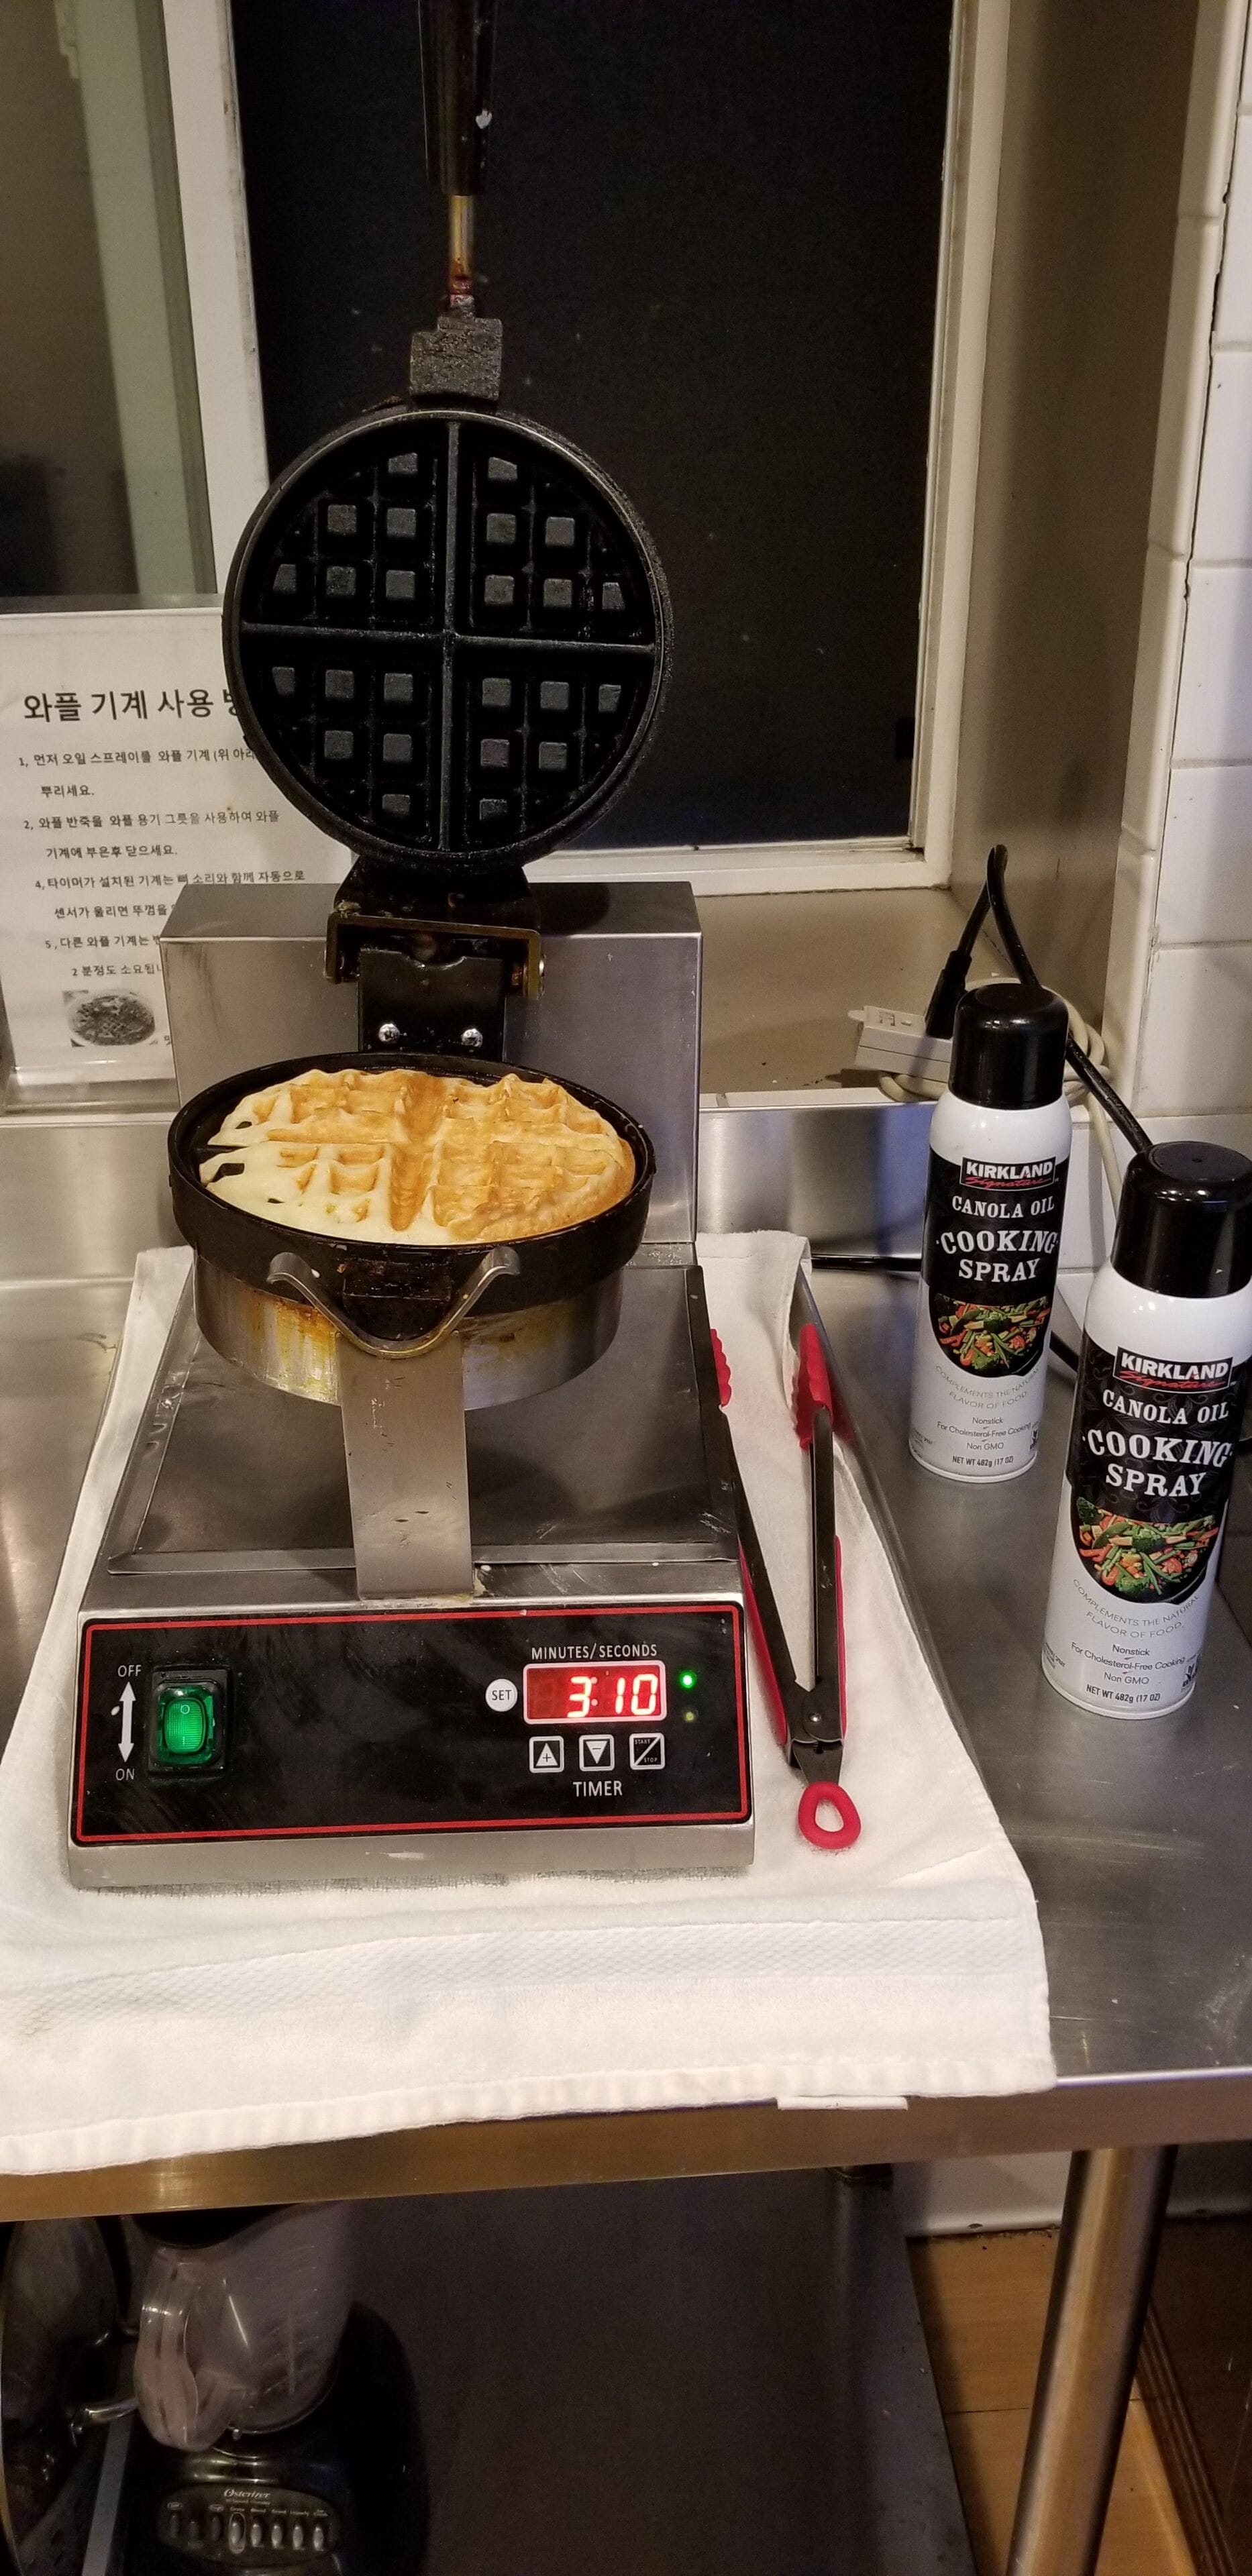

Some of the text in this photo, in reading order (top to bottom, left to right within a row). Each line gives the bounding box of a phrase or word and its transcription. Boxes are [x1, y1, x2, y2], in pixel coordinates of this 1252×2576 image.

[24, 692, 82, 722] 와플
[91, 690, 148, 720] 기계
[157, 689, 214, 718] 사용
[34, 753, 58, 766] 먼저
[62, 752, 86, 765] 오일
[158, 749, 182, 763] 와플
[187, 749, 210, 762] 기계
[41, 785, 95, 798] 뿌리세요.
[38, 816, 62, 829] 와플
[66, 814, 103, 828] 반죽을
[109, 814, 133, 827] 와플
[204, 811, 252, 824] 사용하여
[255, 810, 279, 822] 와플
[46, 847, 83, 859] 기계에
[47, 876, 95, 889] 타이머가
[138, 874, 174, 887] 기계는
[193, 872, 228, 884] 소리와
[54, 906, 90, 919] 센서가
[60, 936, 83, 949] 다른
[114, 934, 150, 947] 기계는
[966, 1161, 1053, 1180] KIRKLAND
[951, 1195, 1055, 1219] CANOLA OIL
[940, 1230, 1059, 1254] COOKING
[958, 1258, 1041, 1283] SPRAY
[1120, 1352, 1229, 1381] KIRKLAND
[1102, 1389, 1229, 1425] CANOLA OIL
[937, 1421, 948, 1431] For
[972, 1416, 1004, 1425] Nonstick
[966, 1442, 1004, 1450] Non GMO
[1087, 1429, 1231, 1468] COOKING
[952, 1455, 964, 1464] NET
[966, 1456, 976, 1466] WT
[1105, 1462, 1207, 1497] SPRAY
[1073, 1578, 1200, 1627] COMPLEMENTS THE NATURAL
[1086, 1611, 1128, 1637] FLAVOR
[531, 1642, 658, 1660] MINUTES/SECONDS
[1071, 1642, 1186, 1671] For Cholesterol-Free Cooking
[1112, 1644, 1151, 1656] Nonstick
[117, 1664, 142, 1677] OFF
[1103, 1671, 1150, 1685] Non GMO
[491, 1688, 513, 1701] SET
[1086, 1683, 1161, 1703] NET WT 482g (17 OZ)
[115, 1768, 135, 1781] ON
[572, 1780, 623, 1798] TIMER
